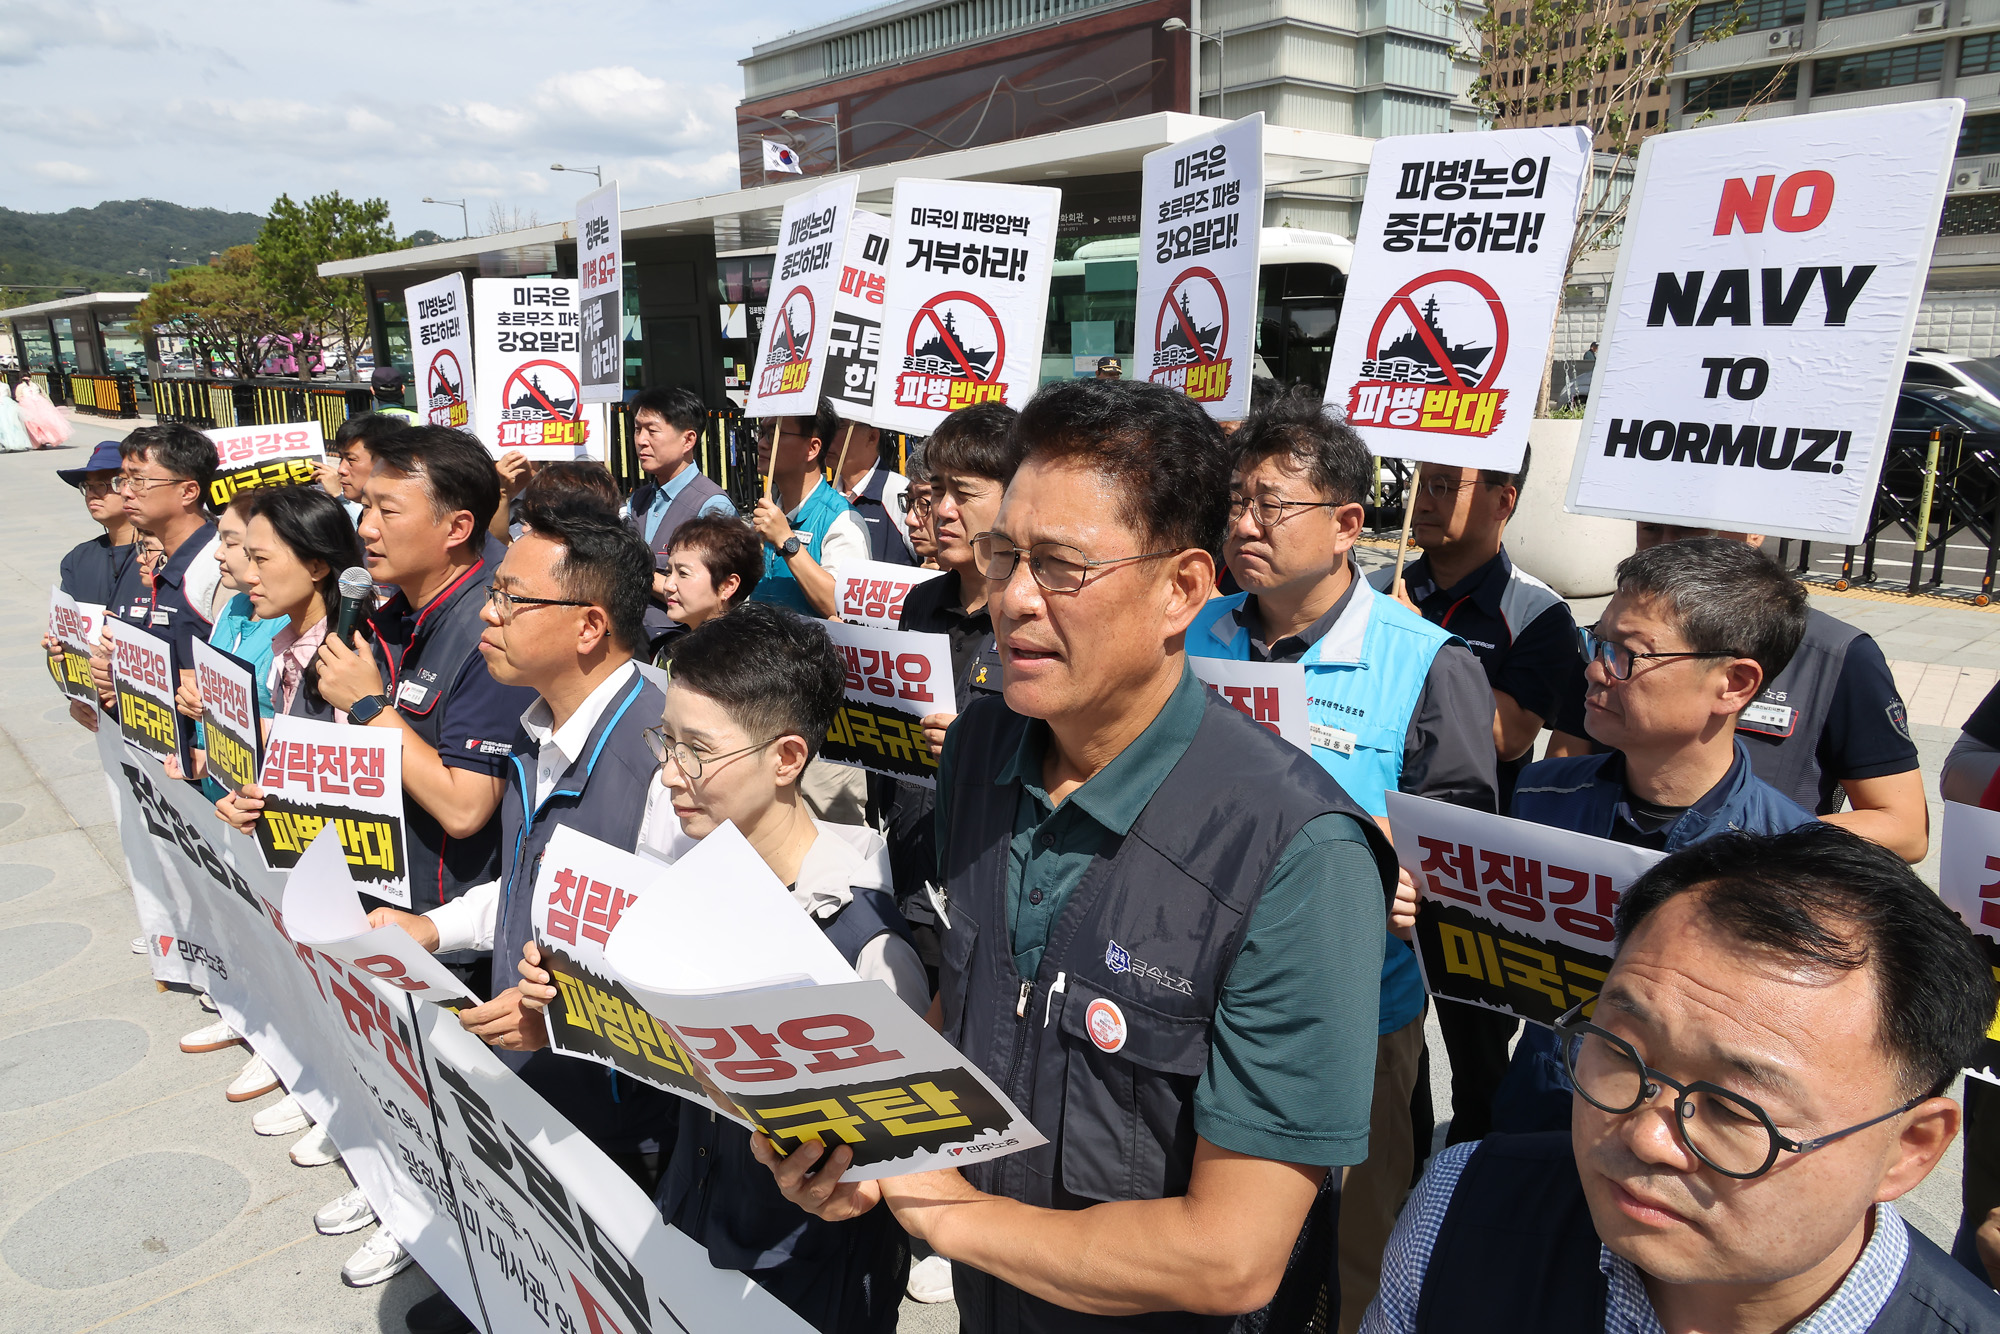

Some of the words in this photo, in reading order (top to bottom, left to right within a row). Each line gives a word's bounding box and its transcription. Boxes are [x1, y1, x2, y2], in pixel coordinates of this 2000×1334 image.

[1173, 144, 1227, 189] 미국은
[1396, 156, 1551, 201] 파병논의
[910, 207, 958, 230] 미국의
[961, 212, 1030, 237] 파병압박
[1158, 192, 1209, 224] 호르무즈
[1211, 179, 1241, 209] 파병
[1712, 169, 1835, 237] NO
[585, 215, 609, 251] 정부는
[788, 206, 837, 247] 파병논의
[1156, 213, 1240, 265] 강요말라!
[1382, 212, 1546, 254] 중단하라!
[781, 241, 830, 281] 중단하라!
[906, 238, 1028, 282] 거부하라!
[418, 291, 457, 320] 파병논의
[513, 287, 570, 307] 미국은
[1646, 264, 1877, 327] NAVY
[420, 316, 461, 346] 중단하라!
[497, 311, 554, 326] 호르무즈
[583, 299, 604, 342] 거부
[592, 334, 618, 379] 하라!
[902, 356, 951, 376] 호르무즈
[1152, 349, 1187, 366] 호르무즈
[1359, 360, 1428, 383] 호르무즈
[759, 360, 810, 397] 파병반대
[900, 376, 1002, 409] 파병반대
[1701, 357, 1769, 401] TO
[430, 402, 468, 427] 파병반대
[501, 409, 542, 421] 호르무즈
[1352, 385, 1499, 434] 파병반대
[502, 421, 586, 444] 파병반대
[1603, 418, 1853, 475] HORMUZ!
[1922, 461, 1934, 504] POLICE
[1917, 511, 1925, 540] LINE
[115, 639, 169, 693] 전쟁강요
[199, 662, 249, 729] 침략전쟁
[121, 691, 175, 749] 미국규탄
[206, 720, 254, 786] 파병반대
[262, 738, 386, 798] 침략전쟁
[547, 868, 638, 952] 침략
[177, 939, 228, 980] 민주노총
[1131, 958, 1194, 996] 금속노조
[552, 969, 694, 1077] 파병반
[658, 1013, 906, 1084] 강요
[733, 1081, 973, 1156] 규탄
[966, 1138, 1019, 1154] 민주노총
[486, 1226, 551, 1329] 대사관
